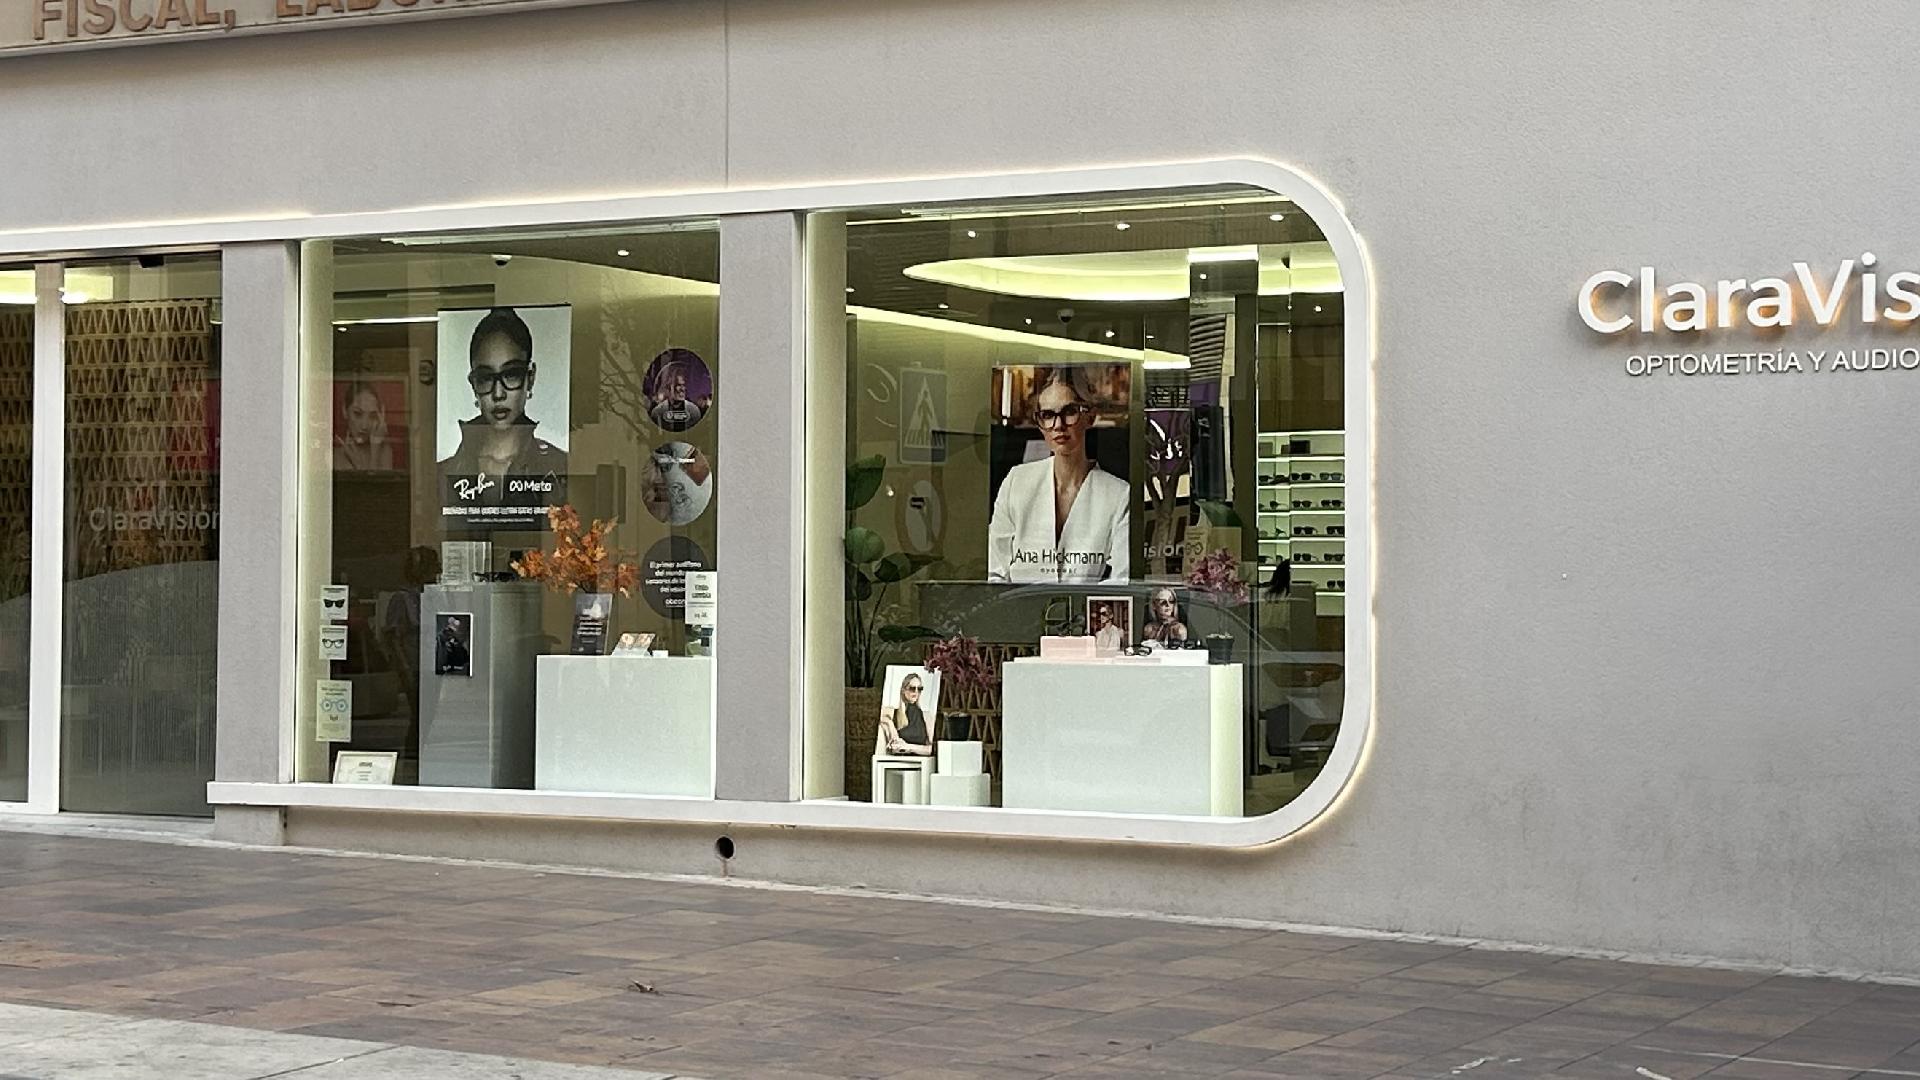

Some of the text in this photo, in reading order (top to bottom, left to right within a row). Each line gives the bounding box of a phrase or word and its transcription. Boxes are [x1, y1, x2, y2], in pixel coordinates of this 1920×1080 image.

[1577, 251, 1920, 334] ClaraVis
[1625, 347, 1920, 376] OPTOMETRÍA Y AUDIO
[523, 480, 553, 492] Meta
[1014, 547, 1105, 565] Ana Hickmann
